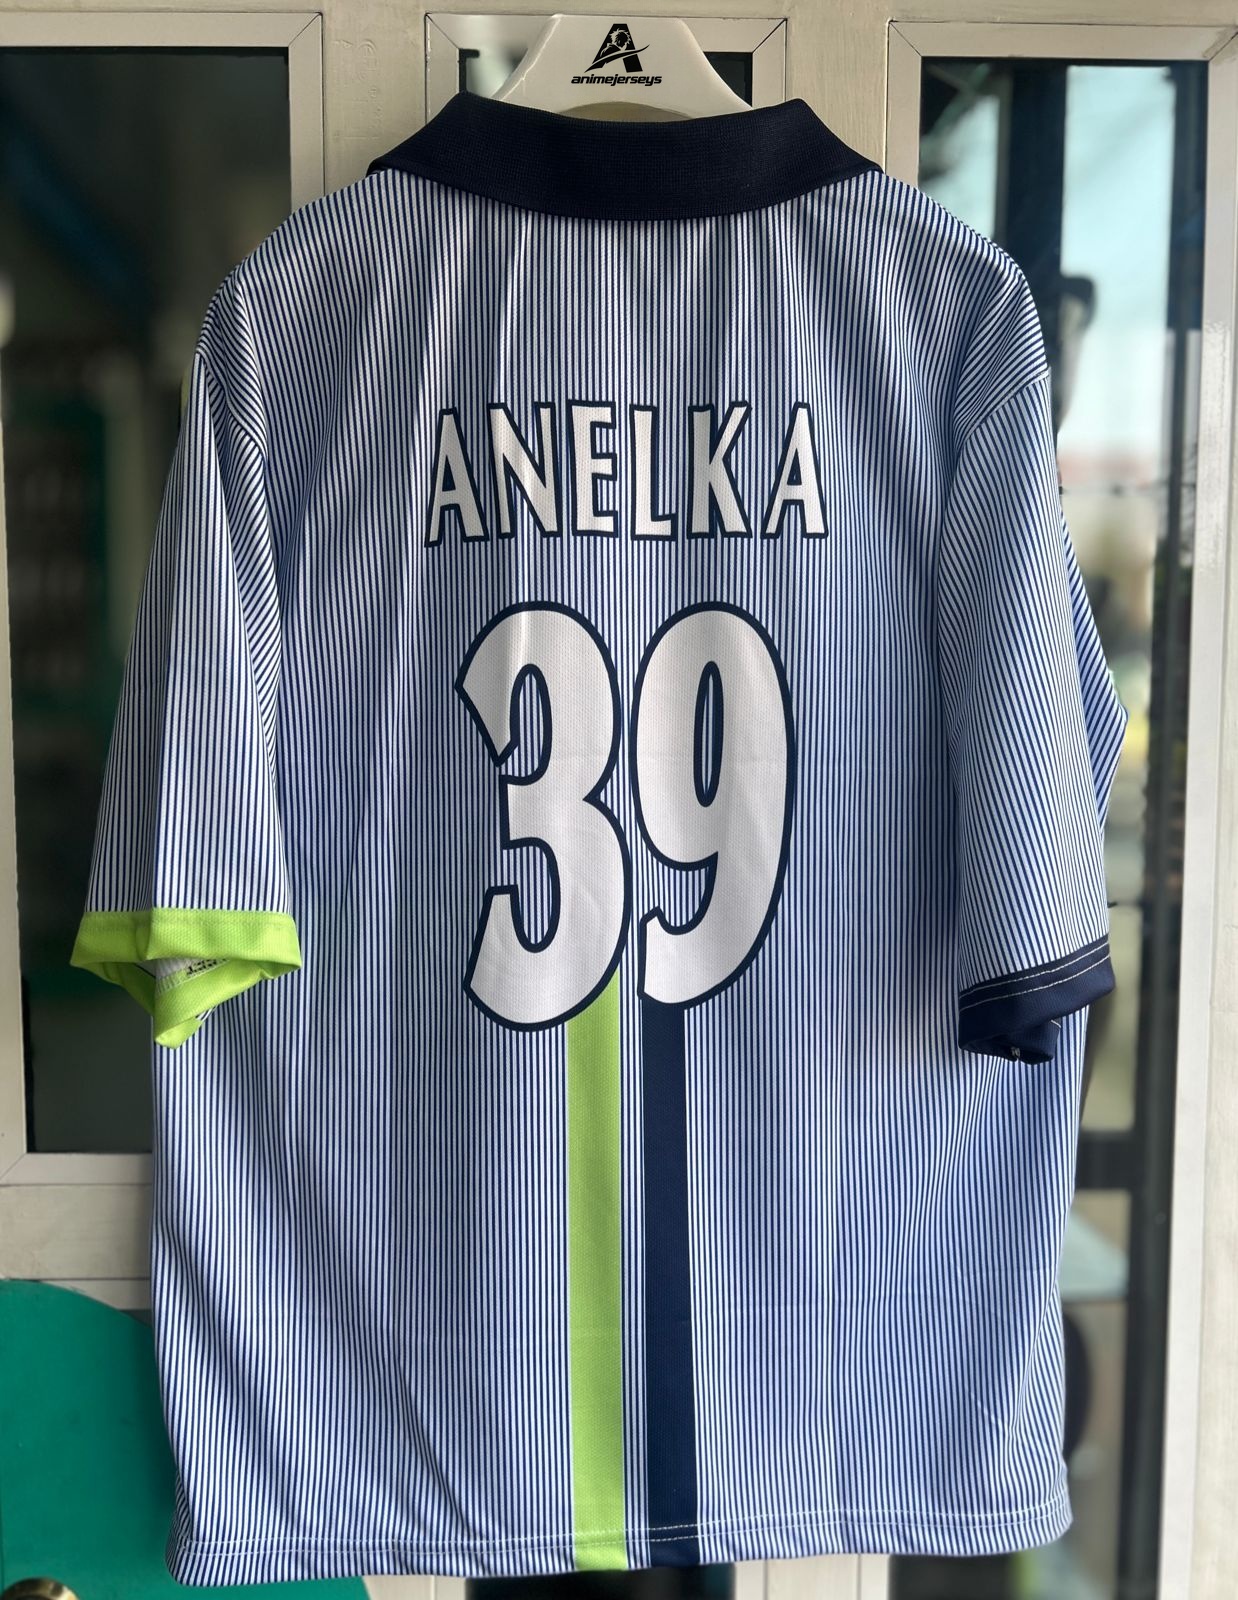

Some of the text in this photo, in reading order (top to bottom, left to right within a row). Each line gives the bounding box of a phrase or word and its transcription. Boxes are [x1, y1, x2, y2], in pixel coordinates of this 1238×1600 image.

[571, 74, 662, 86] animejerseys
[425, 400, 829, 548] ANELKA
[455, 601, 796, 1032] 39
